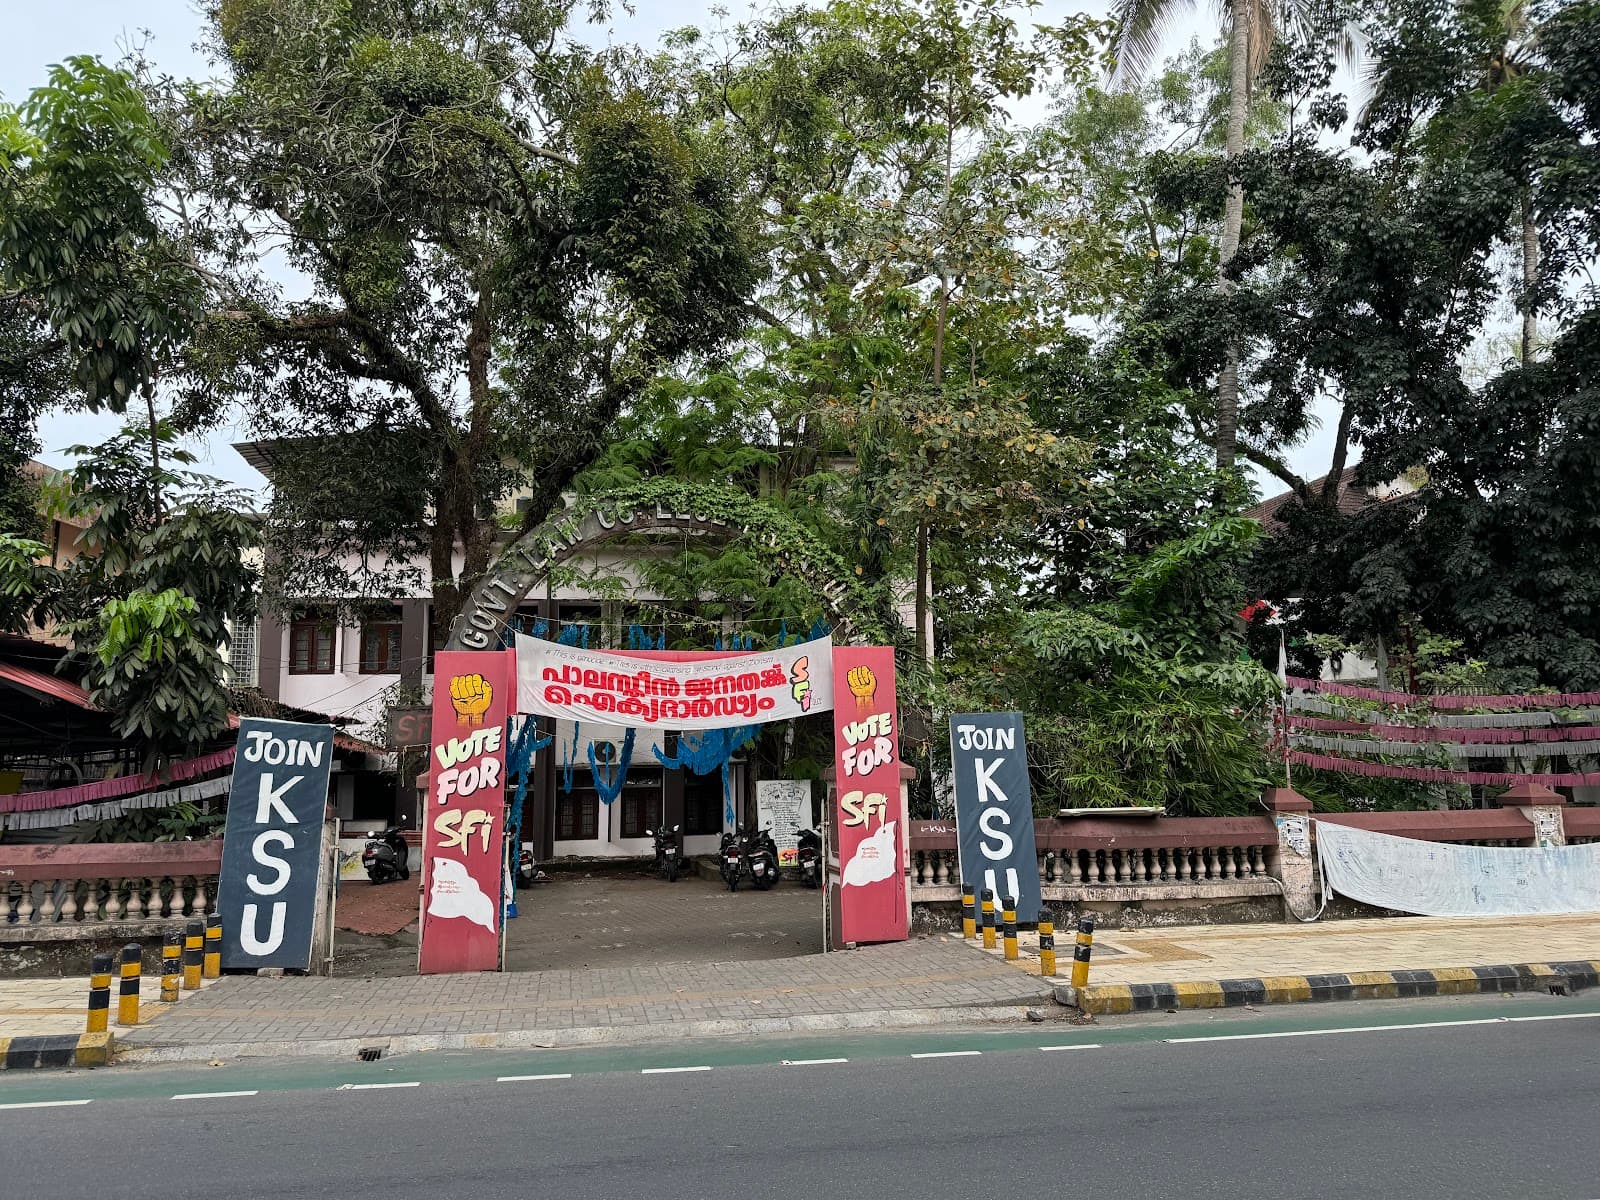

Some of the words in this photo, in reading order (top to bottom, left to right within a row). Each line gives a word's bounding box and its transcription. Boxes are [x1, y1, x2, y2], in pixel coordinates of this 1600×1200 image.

[520, 515, 584, 570] LAW
[244, 731, 326, 768] JOIN
[435, 726, 502, 770] VOTE
[842, 712, 892, 747] VOTE
[957, 725, 1015, 751] JOIN
[842, 737, 893, 777] FOR
[437, 757, 499, 805] FOR
